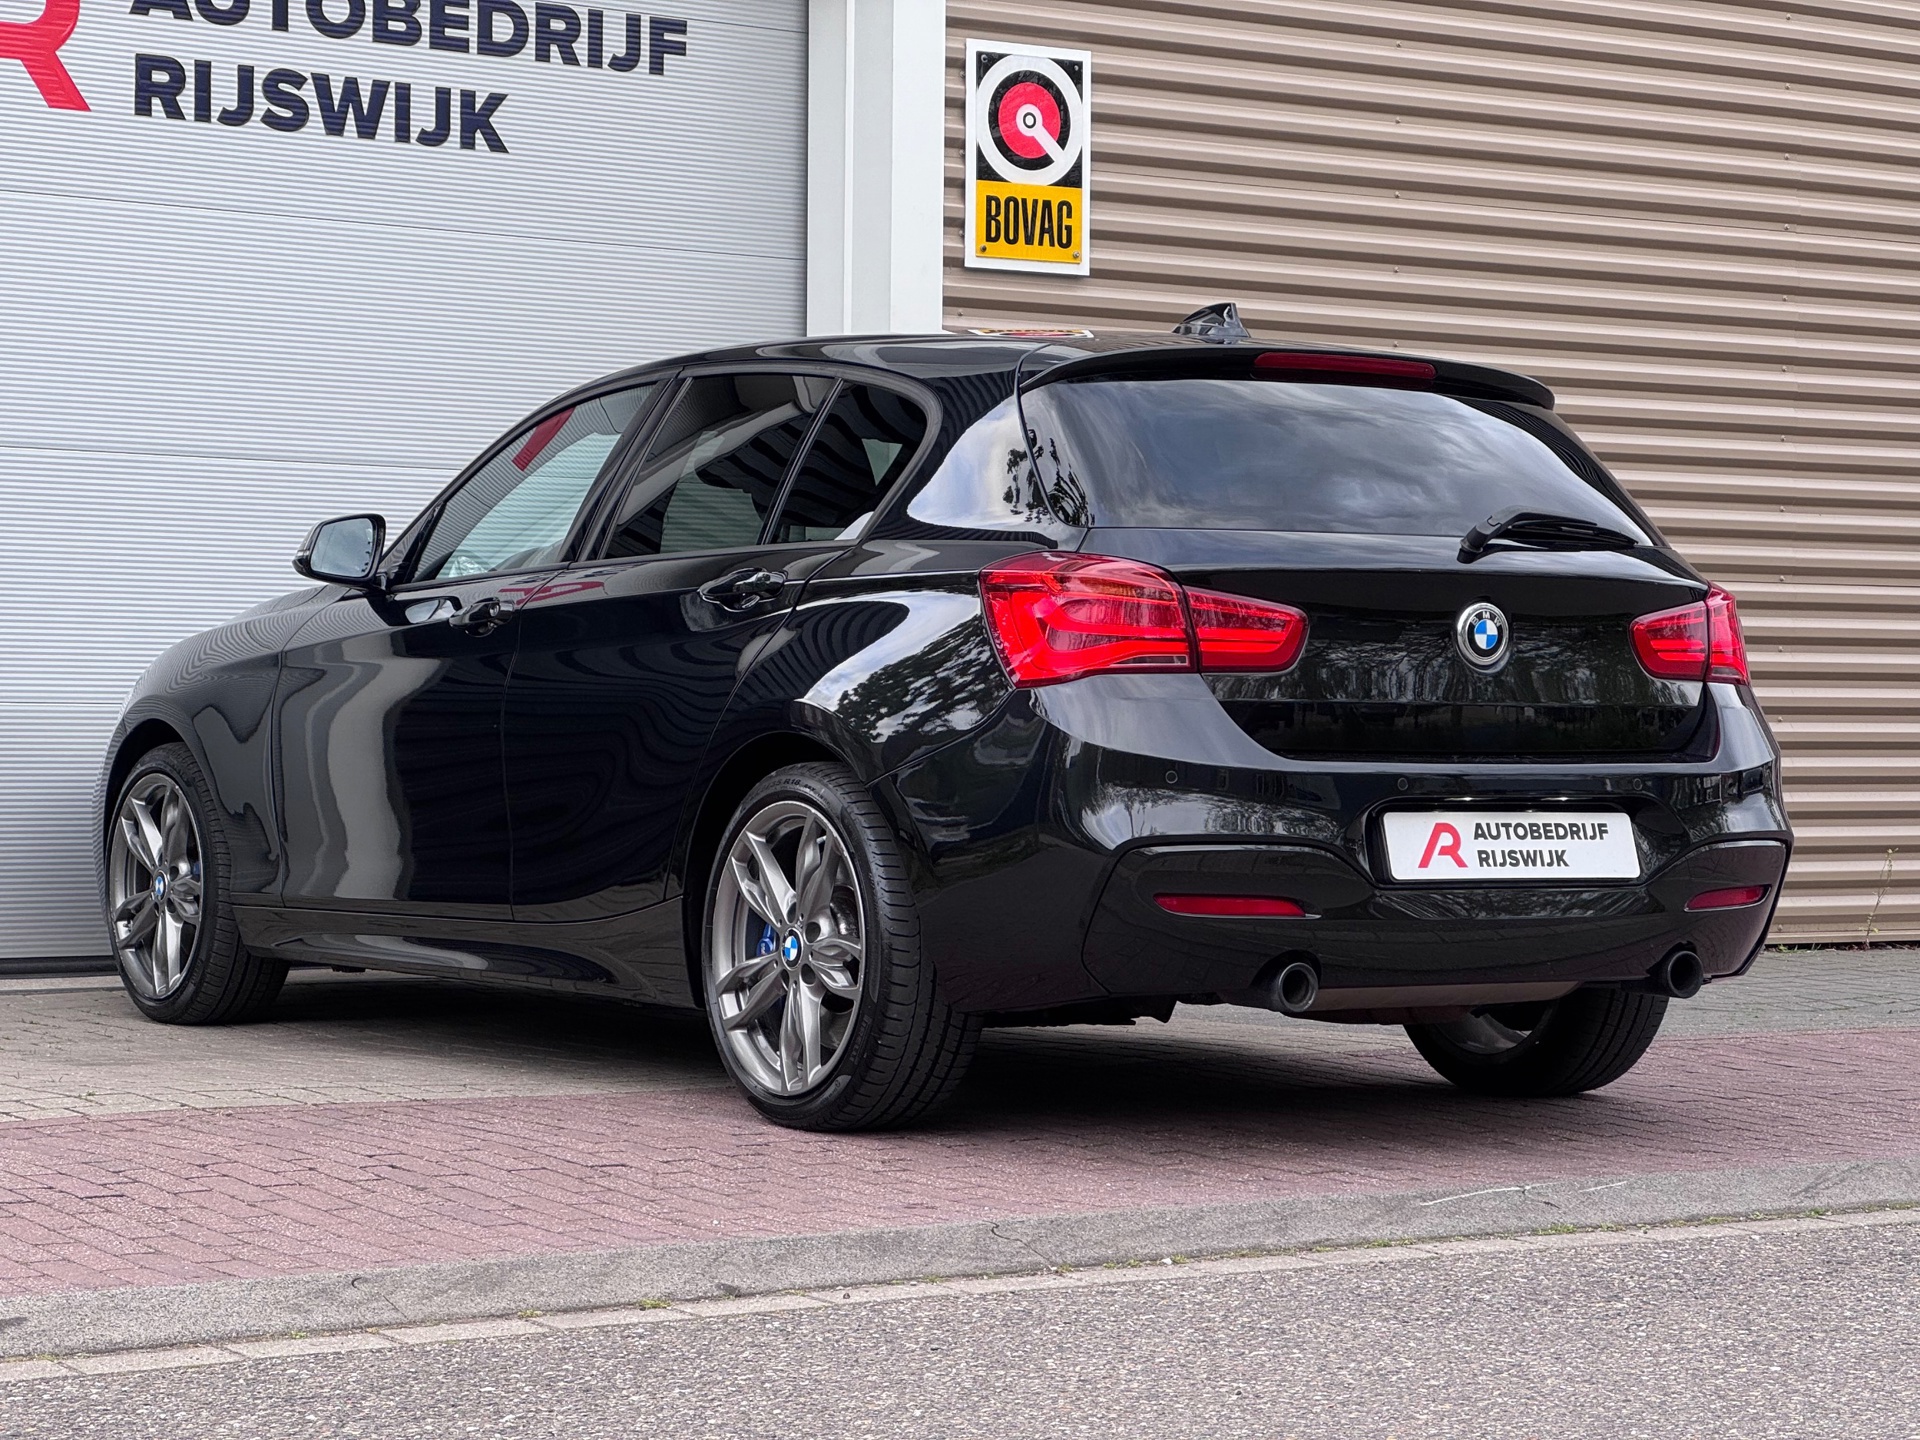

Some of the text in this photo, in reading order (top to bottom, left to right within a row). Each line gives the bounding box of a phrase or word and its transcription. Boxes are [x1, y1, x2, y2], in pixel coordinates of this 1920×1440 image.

[129, 0, 688, 76] OBEDRIJF
[134, 53, 509, 153] RIJSWIJK
[985, 195, 1072, 249] BOVAG
[1470, 610, 1502, 627] BMW
[1473, 822, 1609, 840] AUTOBEDRIJF
[1478, 849, 1570, 868] RIJSWIJK
